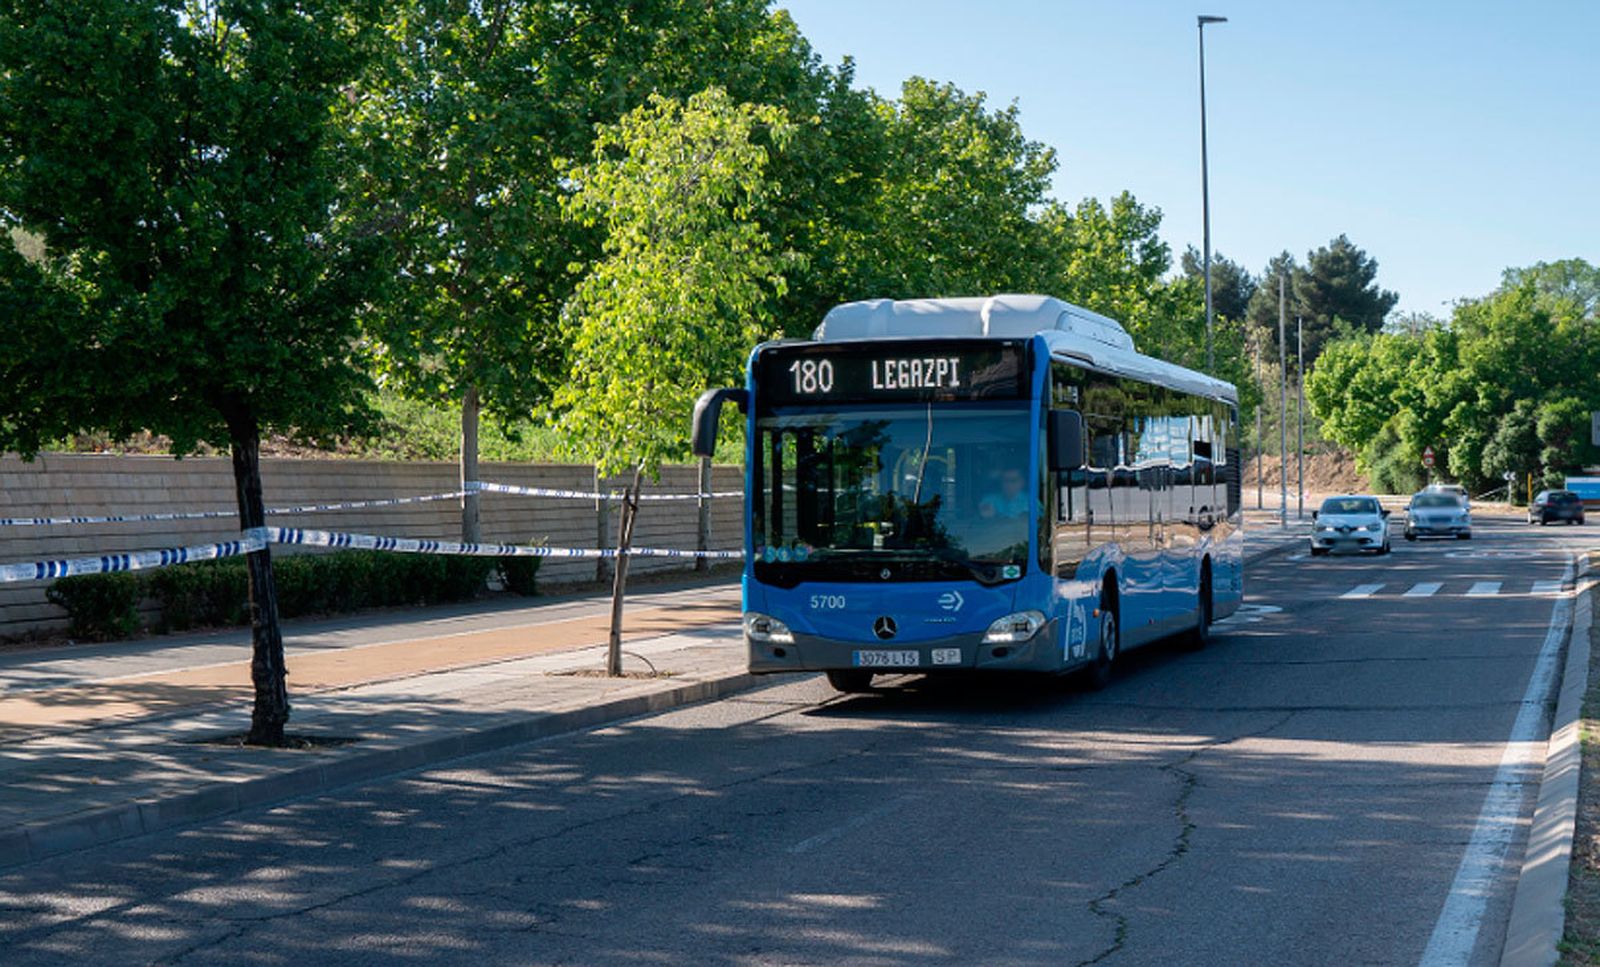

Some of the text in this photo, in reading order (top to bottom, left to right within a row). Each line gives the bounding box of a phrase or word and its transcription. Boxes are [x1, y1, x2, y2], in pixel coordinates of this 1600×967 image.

[789, 357, 960, 393] 180 LEGAZPI
[811, 595, 846, 609] 5700
